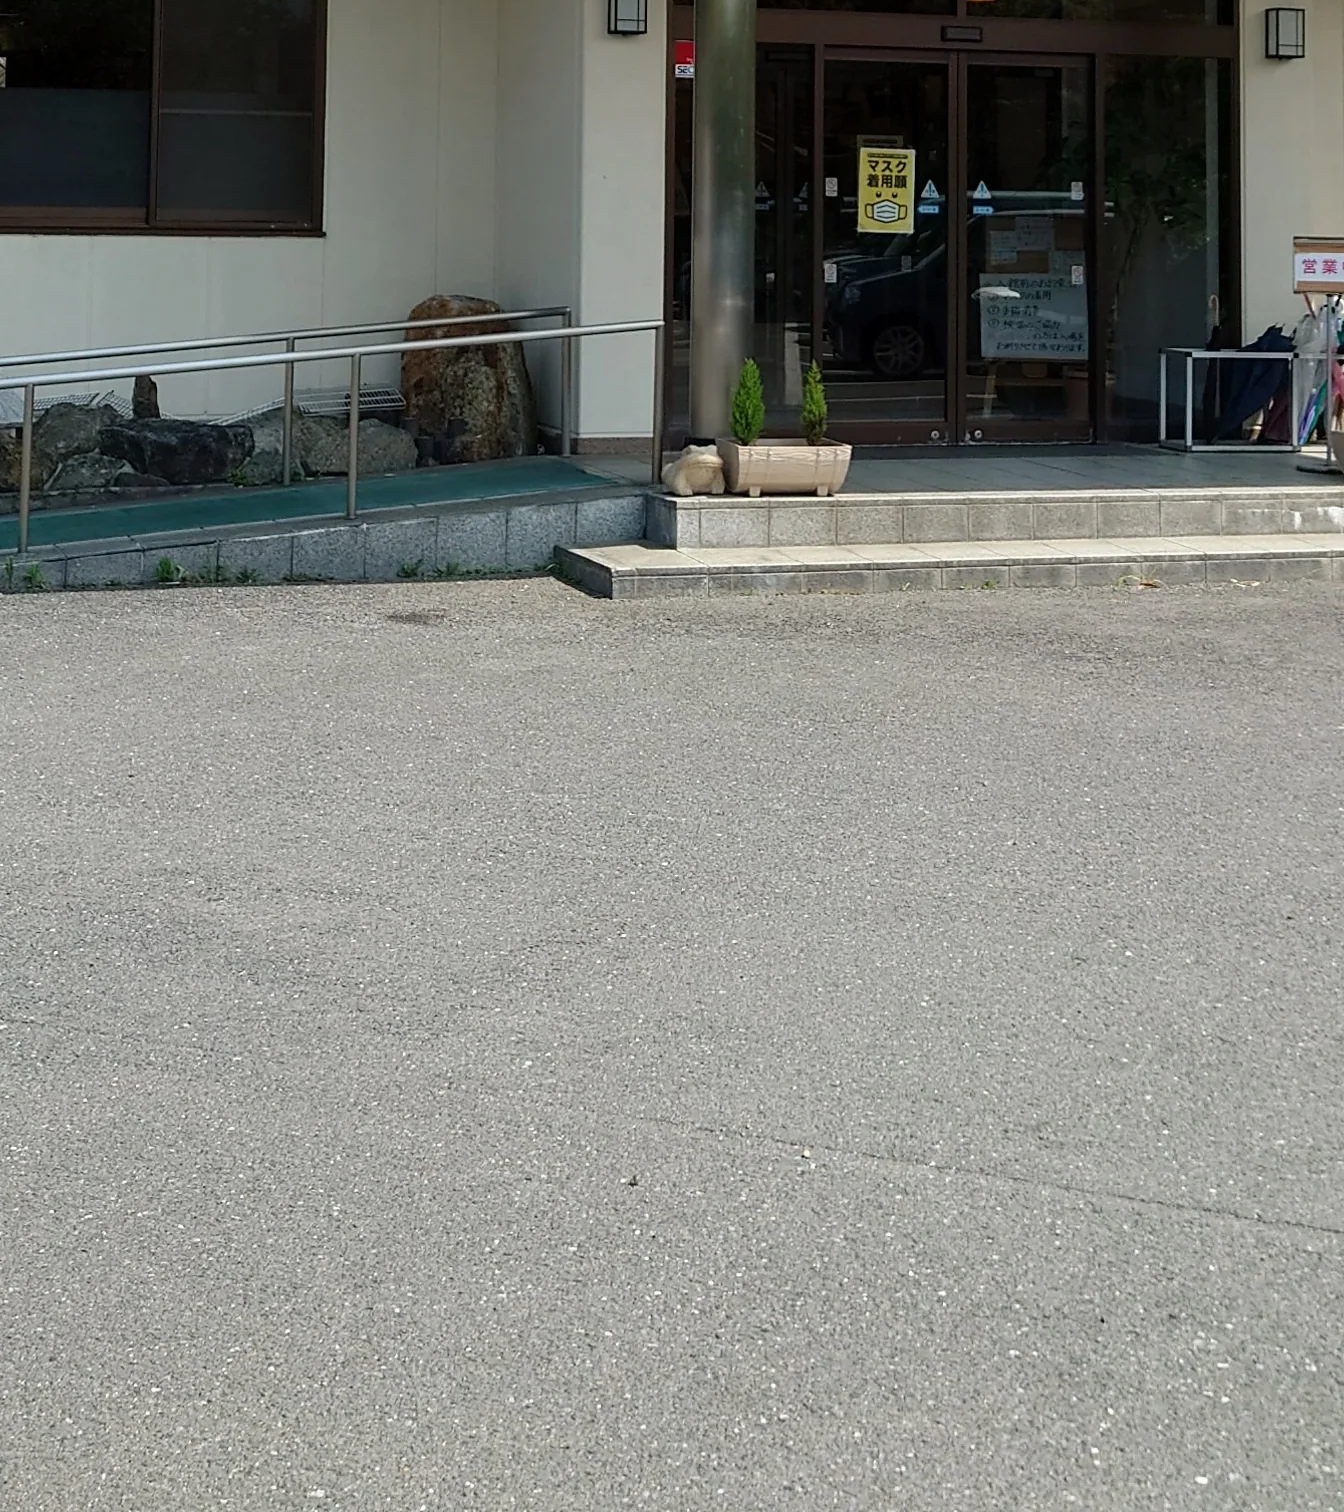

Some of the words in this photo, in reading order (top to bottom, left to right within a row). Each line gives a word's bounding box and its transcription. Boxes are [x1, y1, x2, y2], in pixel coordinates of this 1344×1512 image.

[867, 159, 907, 173] マスク
[867, 174, 907, 188] 着用願
